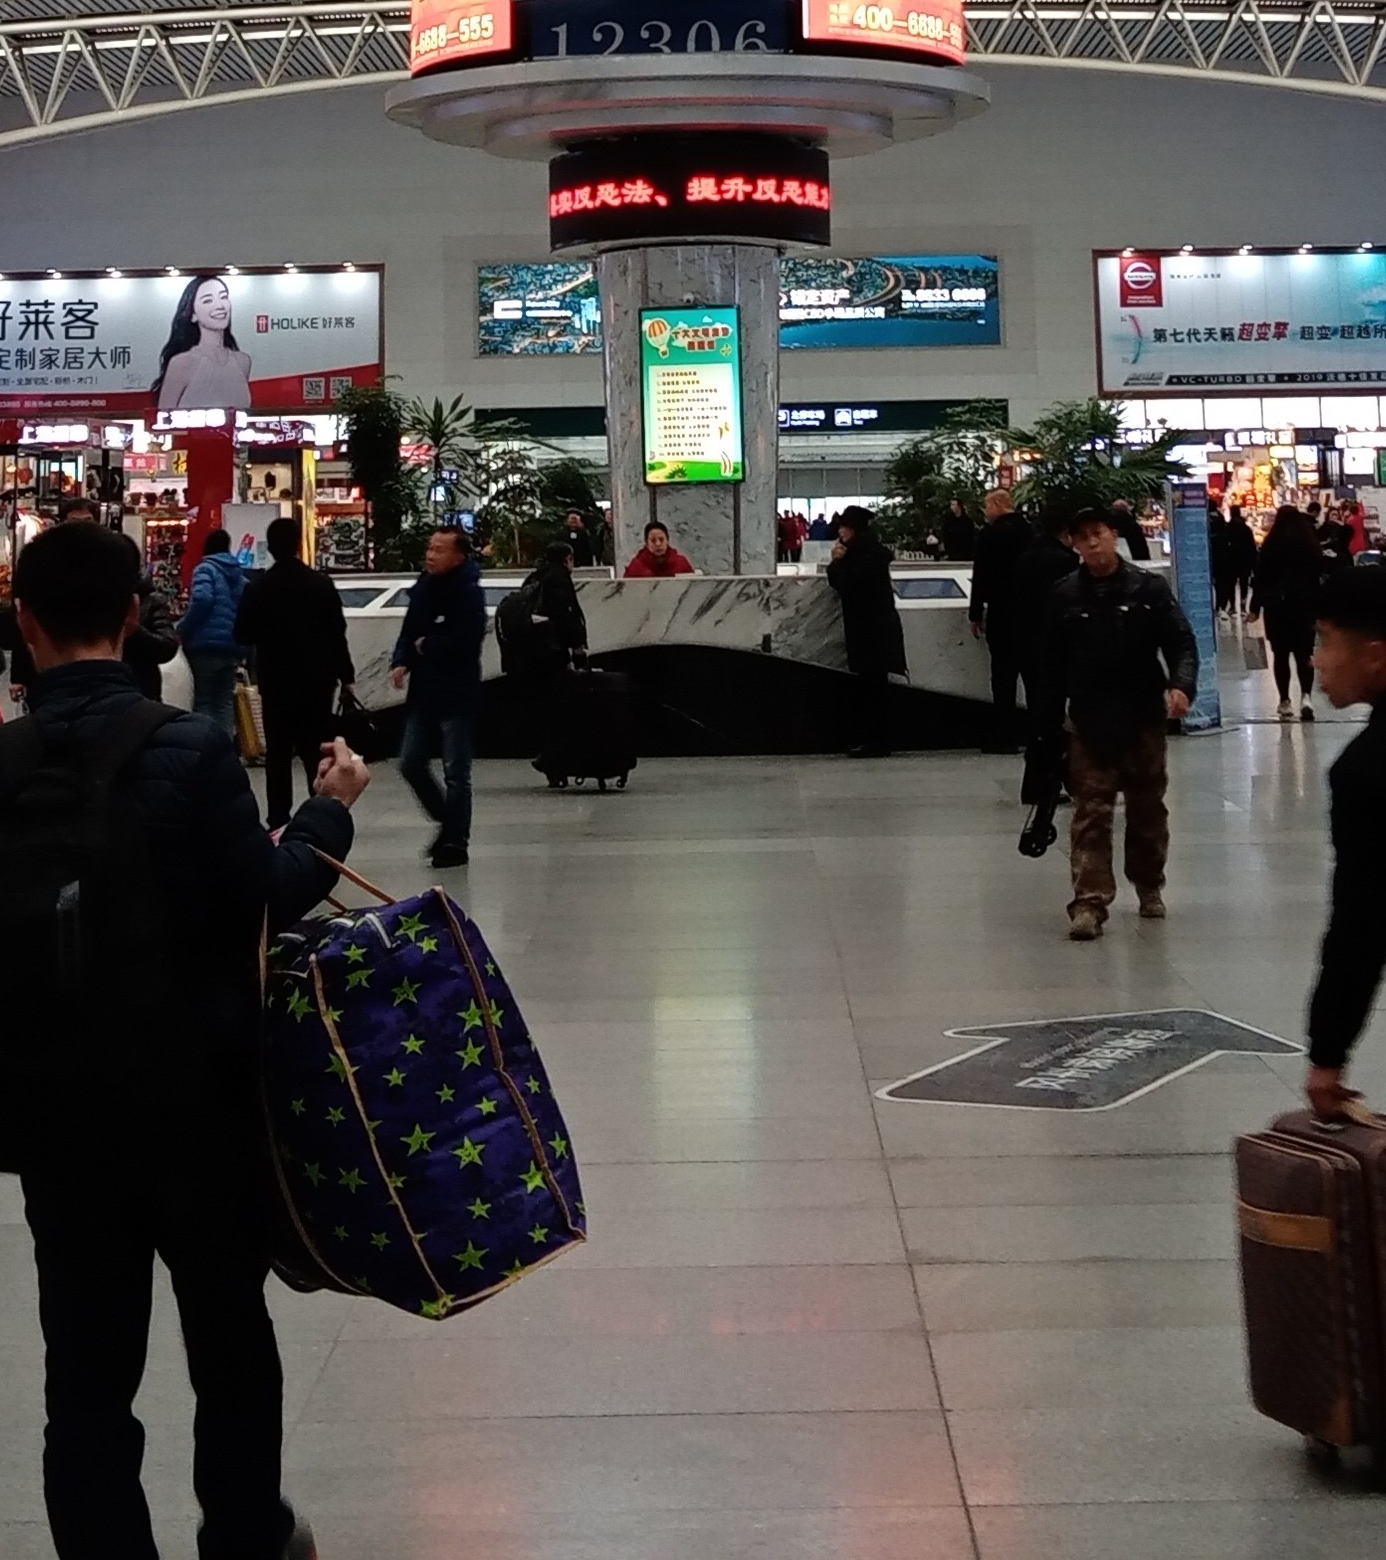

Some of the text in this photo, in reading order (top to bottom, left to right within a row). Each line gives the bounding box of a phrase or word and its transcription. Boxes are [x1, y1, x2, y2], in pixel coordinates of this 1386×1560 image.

[549, 19, 767, 58] 12306
[270, 316, 356, 330] HOLIKE 好莱客
[1296, 373, 1324, 383] 2019
